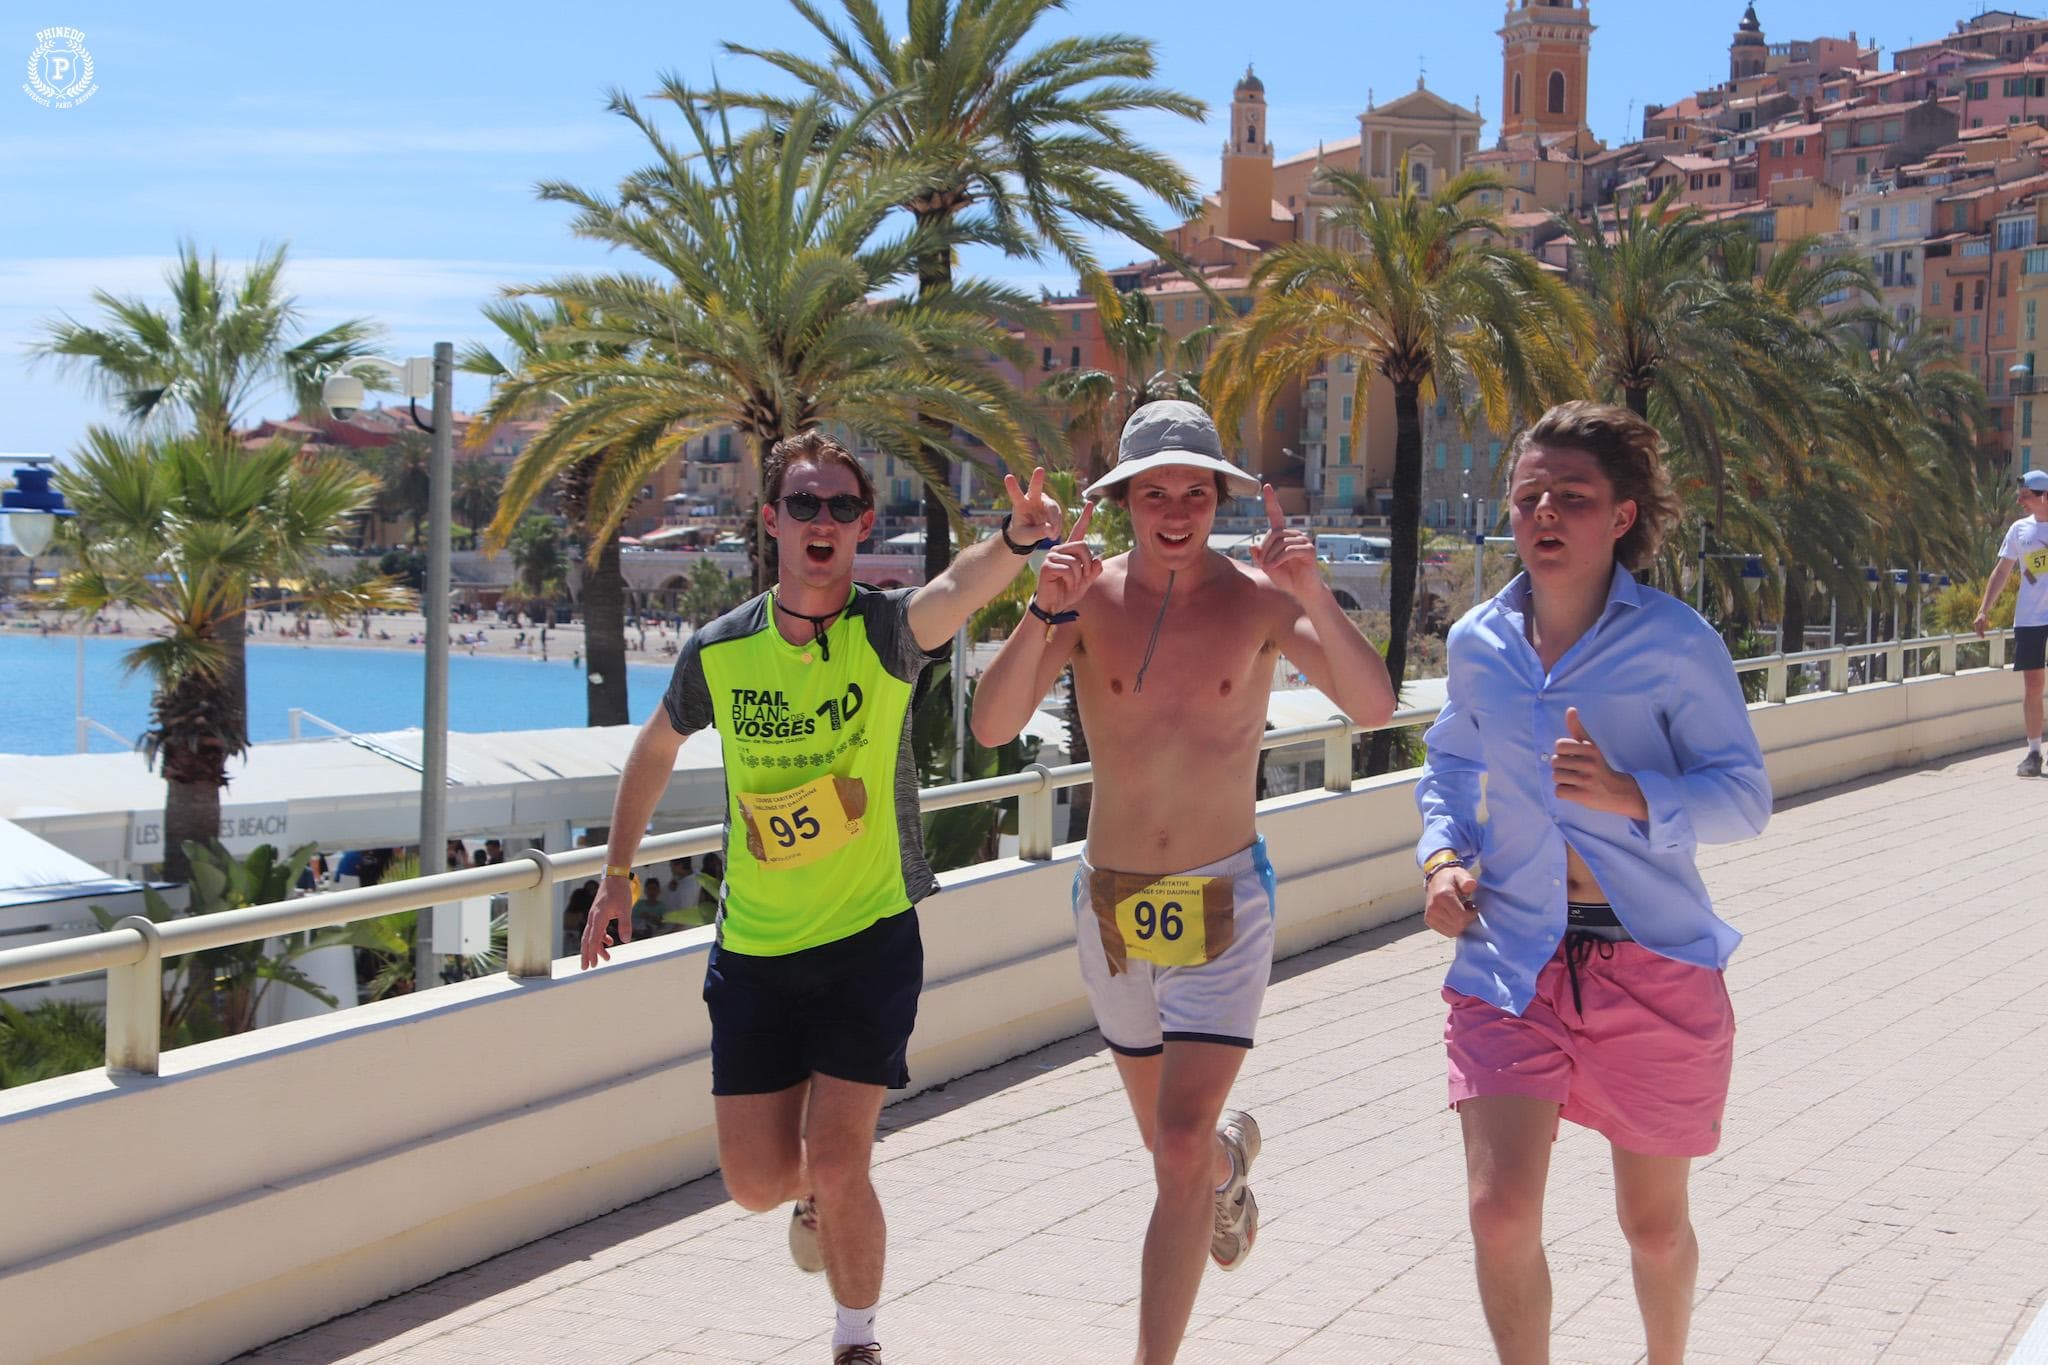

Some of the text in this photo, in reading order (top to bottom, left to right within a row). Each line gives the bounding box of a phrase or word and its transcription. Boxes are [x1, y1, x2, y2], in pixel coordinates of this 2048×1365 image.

[2034, 555, 2046, 568] 57
[731, 689, 789, 706] TRAIL
[732, 704, 806, 722] BLANC DES
[733, 719, 816, 738] VOSGES
[136, 824, 160, 845] LES
[239, 815, 287, 837] BEACH
[769, 805, 821, 848] 95
[1134, 901, 1184, 941] 96
